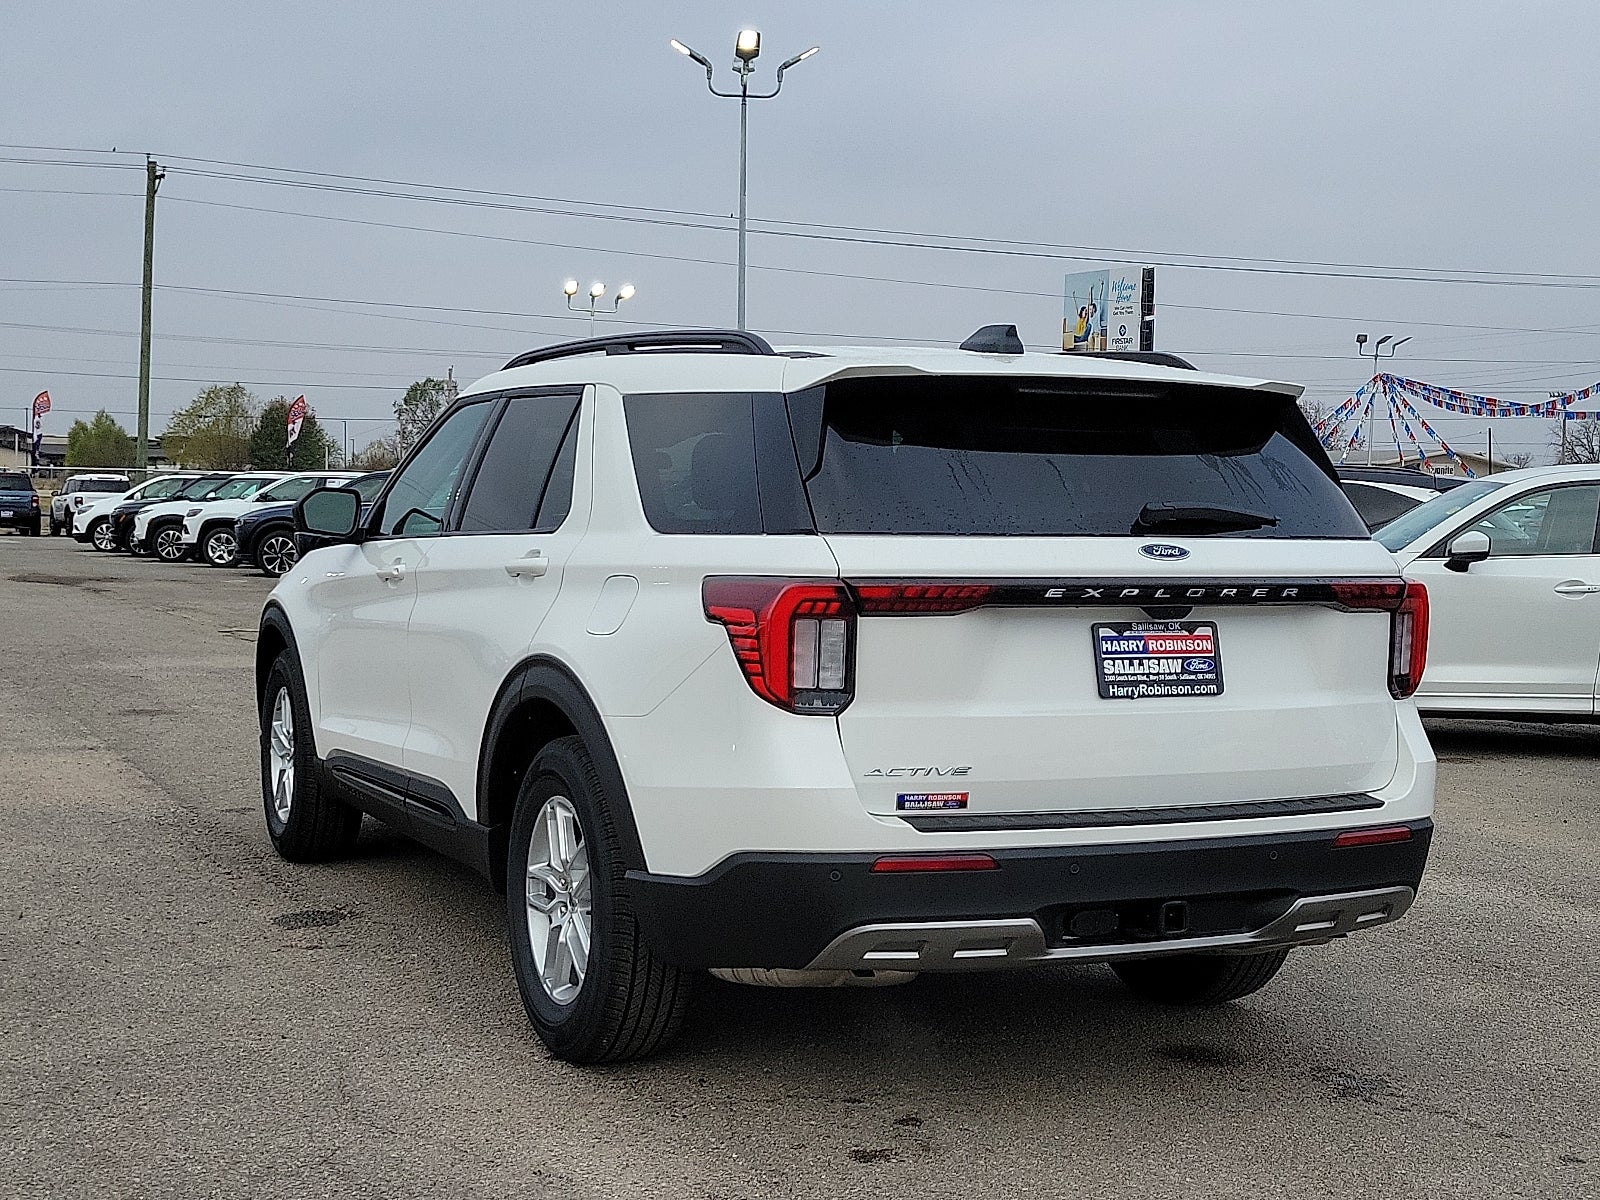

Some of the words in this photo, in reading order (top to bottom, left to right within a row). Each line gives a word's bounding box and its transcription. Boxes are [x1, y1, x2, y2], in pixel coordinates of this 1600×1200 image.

[1111, 337, 1133, 345] FIRSTAR
[1043, 587, 1300, 599] EXPLORER
[1131, 622, 1167, 632] Sallisaw,
[1168, 622, 1181, 630] OK
[1102, 639, 1145, 652] HARRY
[1148, 639, 1212, 651] ROBINSON
[1103, 659, 1182, 674] SALLISAW
[1188, 658, 1211, 671] Ford
[1109, 684, 1217, 699] HarryRobinson.com
[863, 766, 972, 776] ACTIVE
